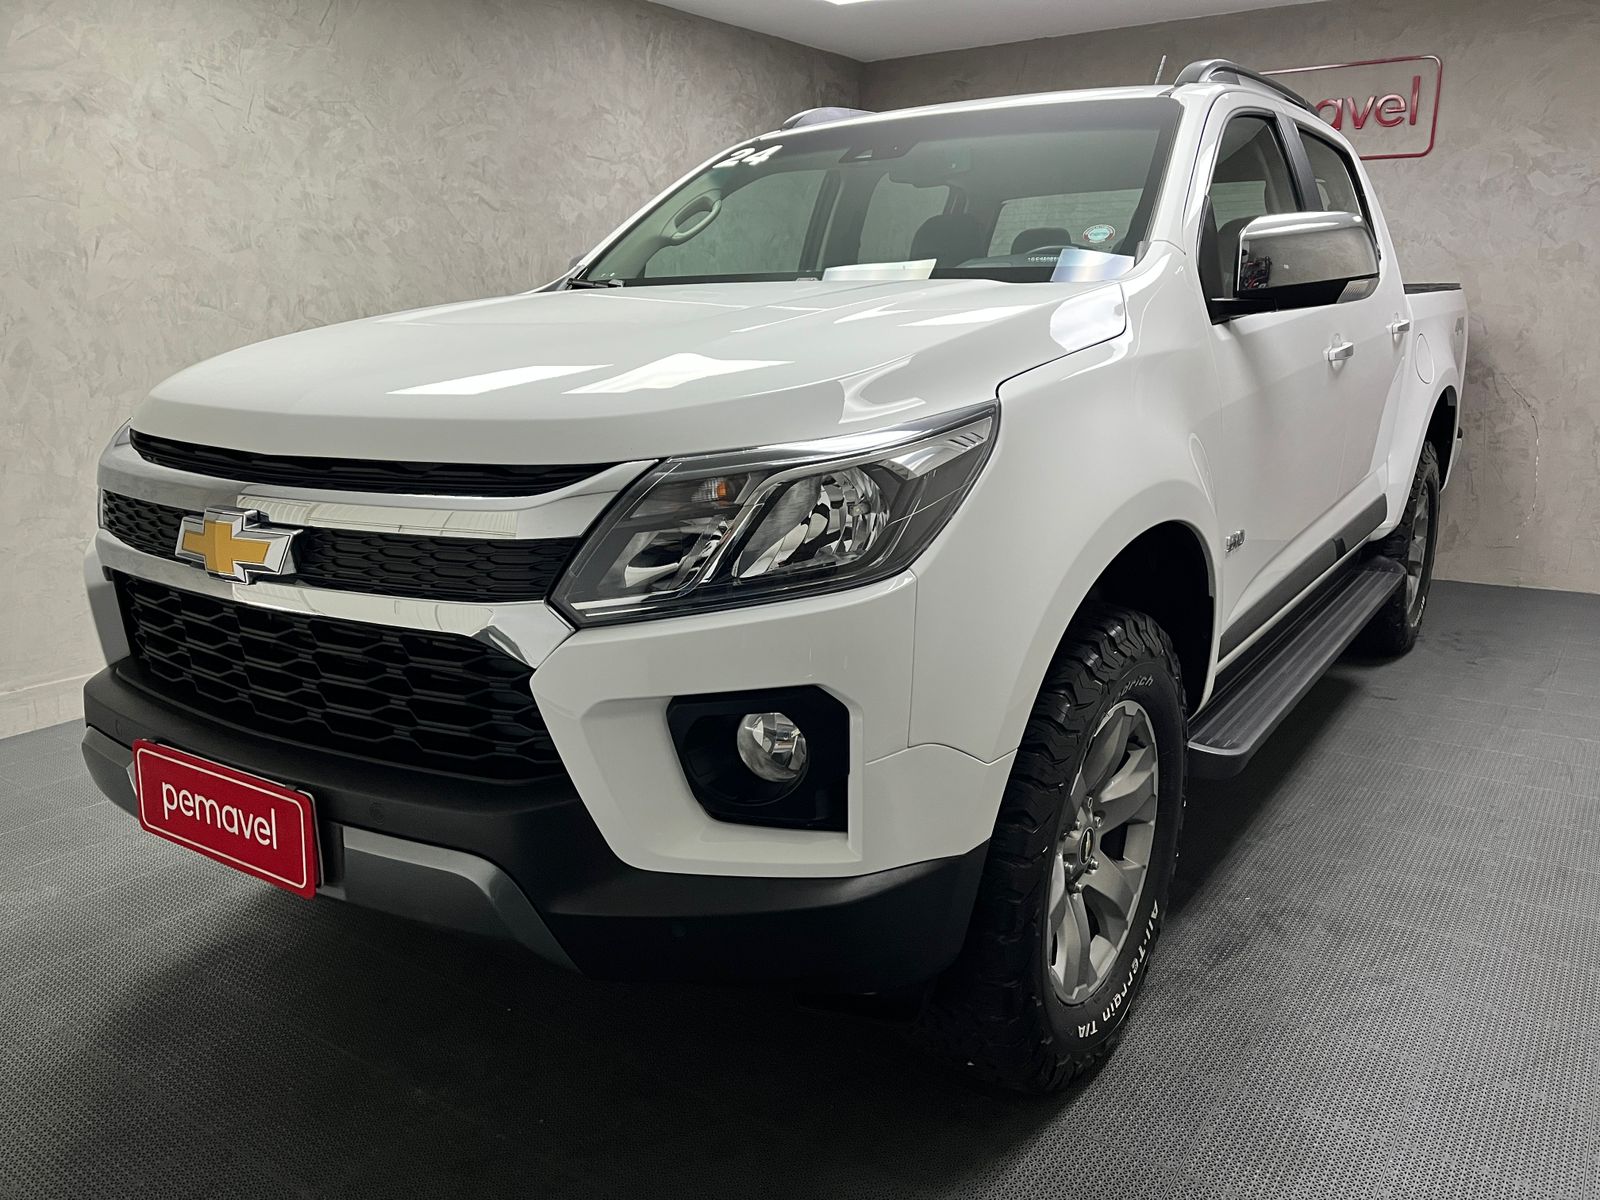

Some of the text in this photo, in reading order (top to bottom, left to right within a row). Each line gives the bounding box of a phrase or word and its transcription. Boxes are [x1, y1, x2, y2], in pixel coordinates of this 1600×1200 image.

[1314, 75, 1421, 130] avel
[712, 144, 783, 169] 24
[161, 781, 277, 850] pemavel
[1077, 1020, 1098, 1038] T/A
